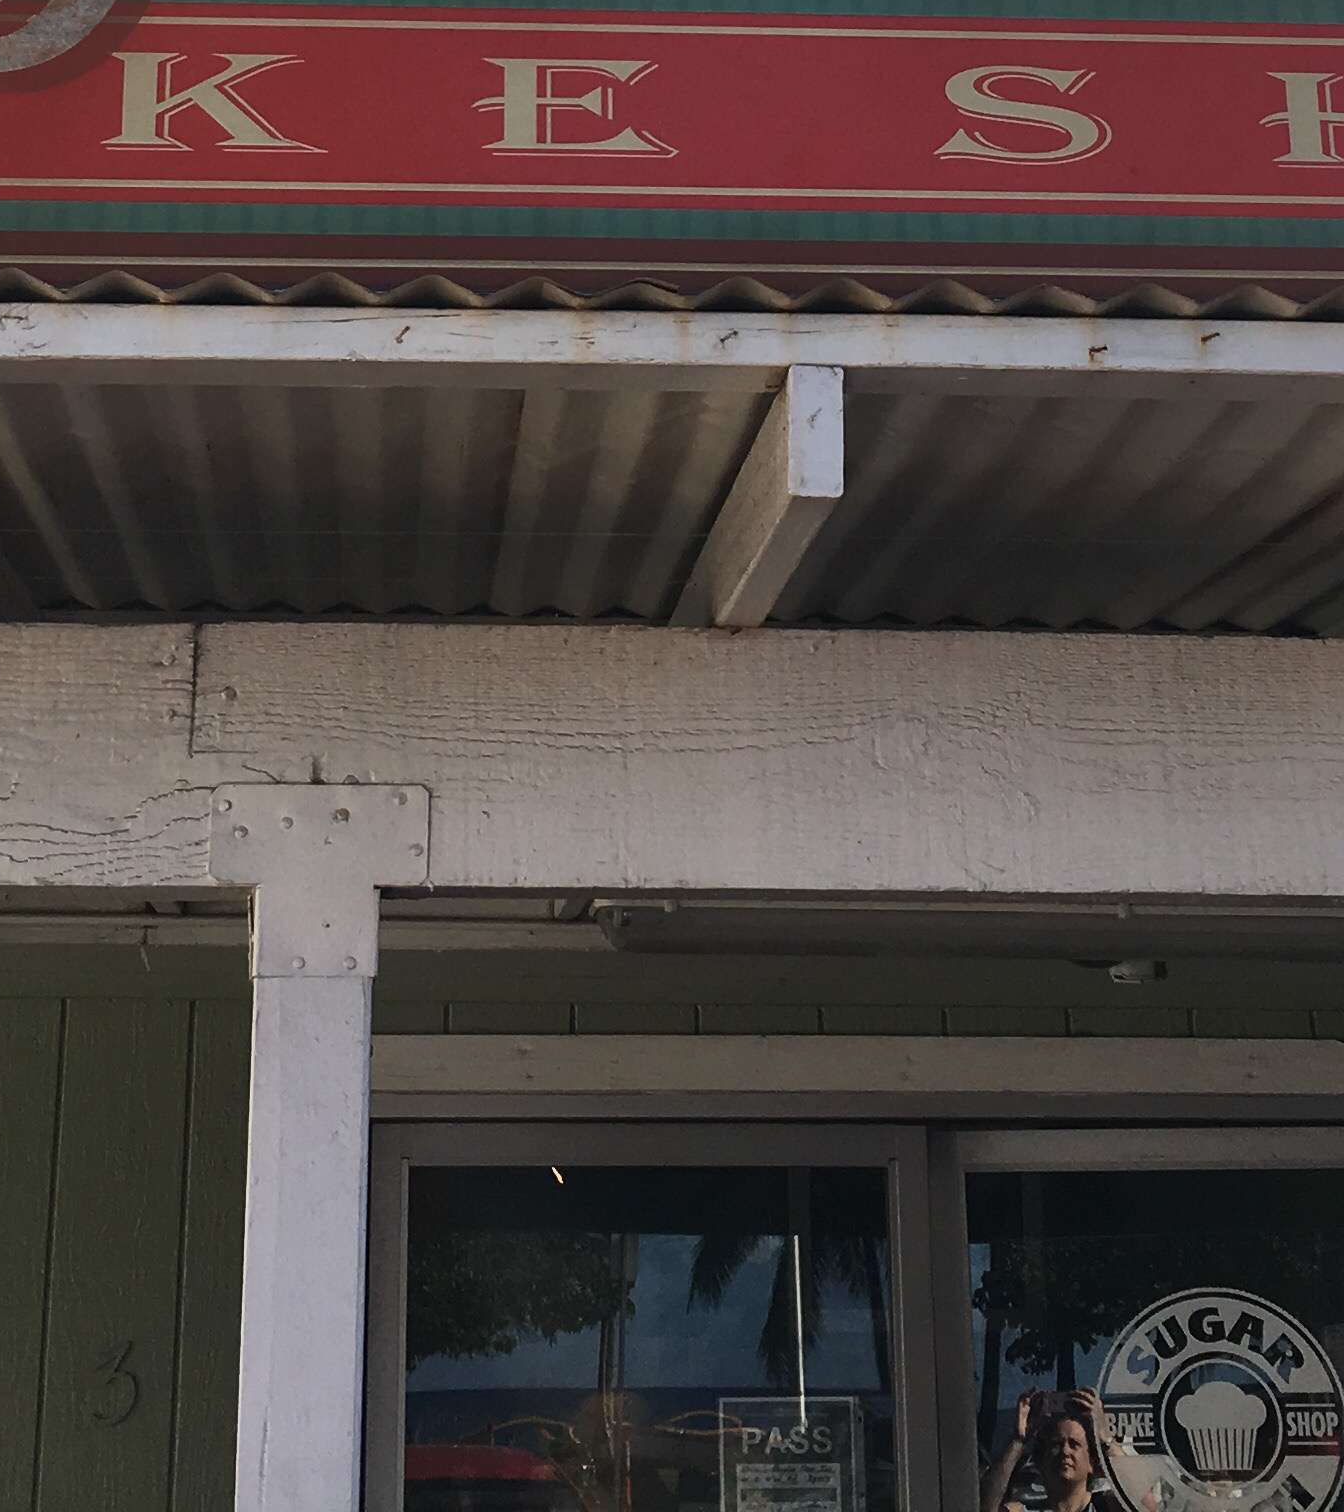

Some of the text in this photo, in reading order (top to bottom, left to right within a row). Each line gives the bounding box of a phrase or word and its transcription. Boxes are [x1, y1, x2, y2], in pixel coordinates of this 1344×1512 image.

[1127, 1306, 1304, 1386] SUGAR
[1104, 1411, 1339, 1438] BAKE SHOP
[742, 1426, 833, 1455] PASS
